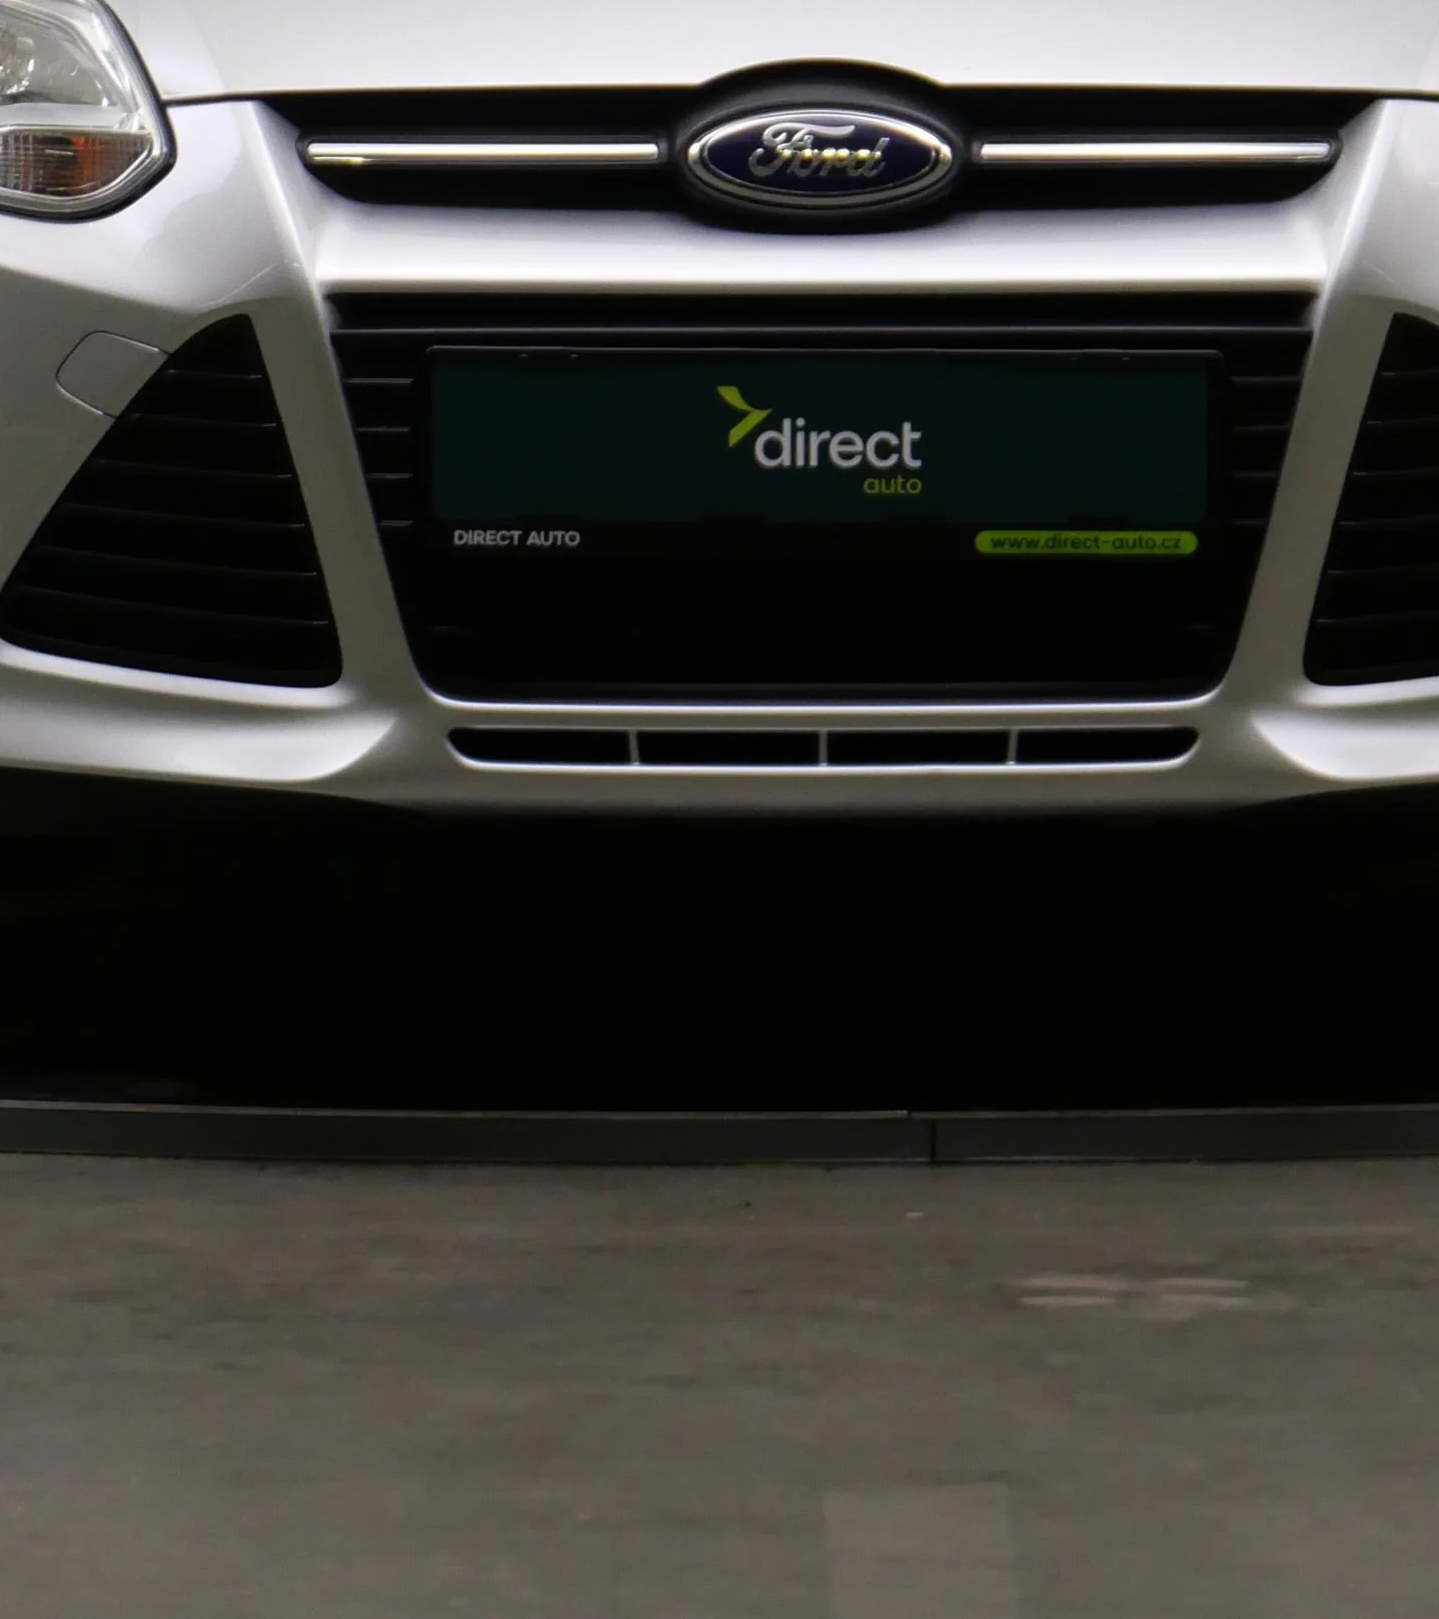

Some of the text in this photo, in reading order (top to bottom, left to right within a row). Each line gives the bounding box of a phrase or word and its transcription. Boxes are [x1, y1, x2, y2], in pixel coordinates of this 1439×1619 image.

[748, 121, 890, 178] Ford
[754, 416, 923, 469] direct
[863, 475, 923, 495] auto
[453, 529, 581, 547] DIRECT AUTO
[990, 533, 1182, 550] www.direct-auto.cz
